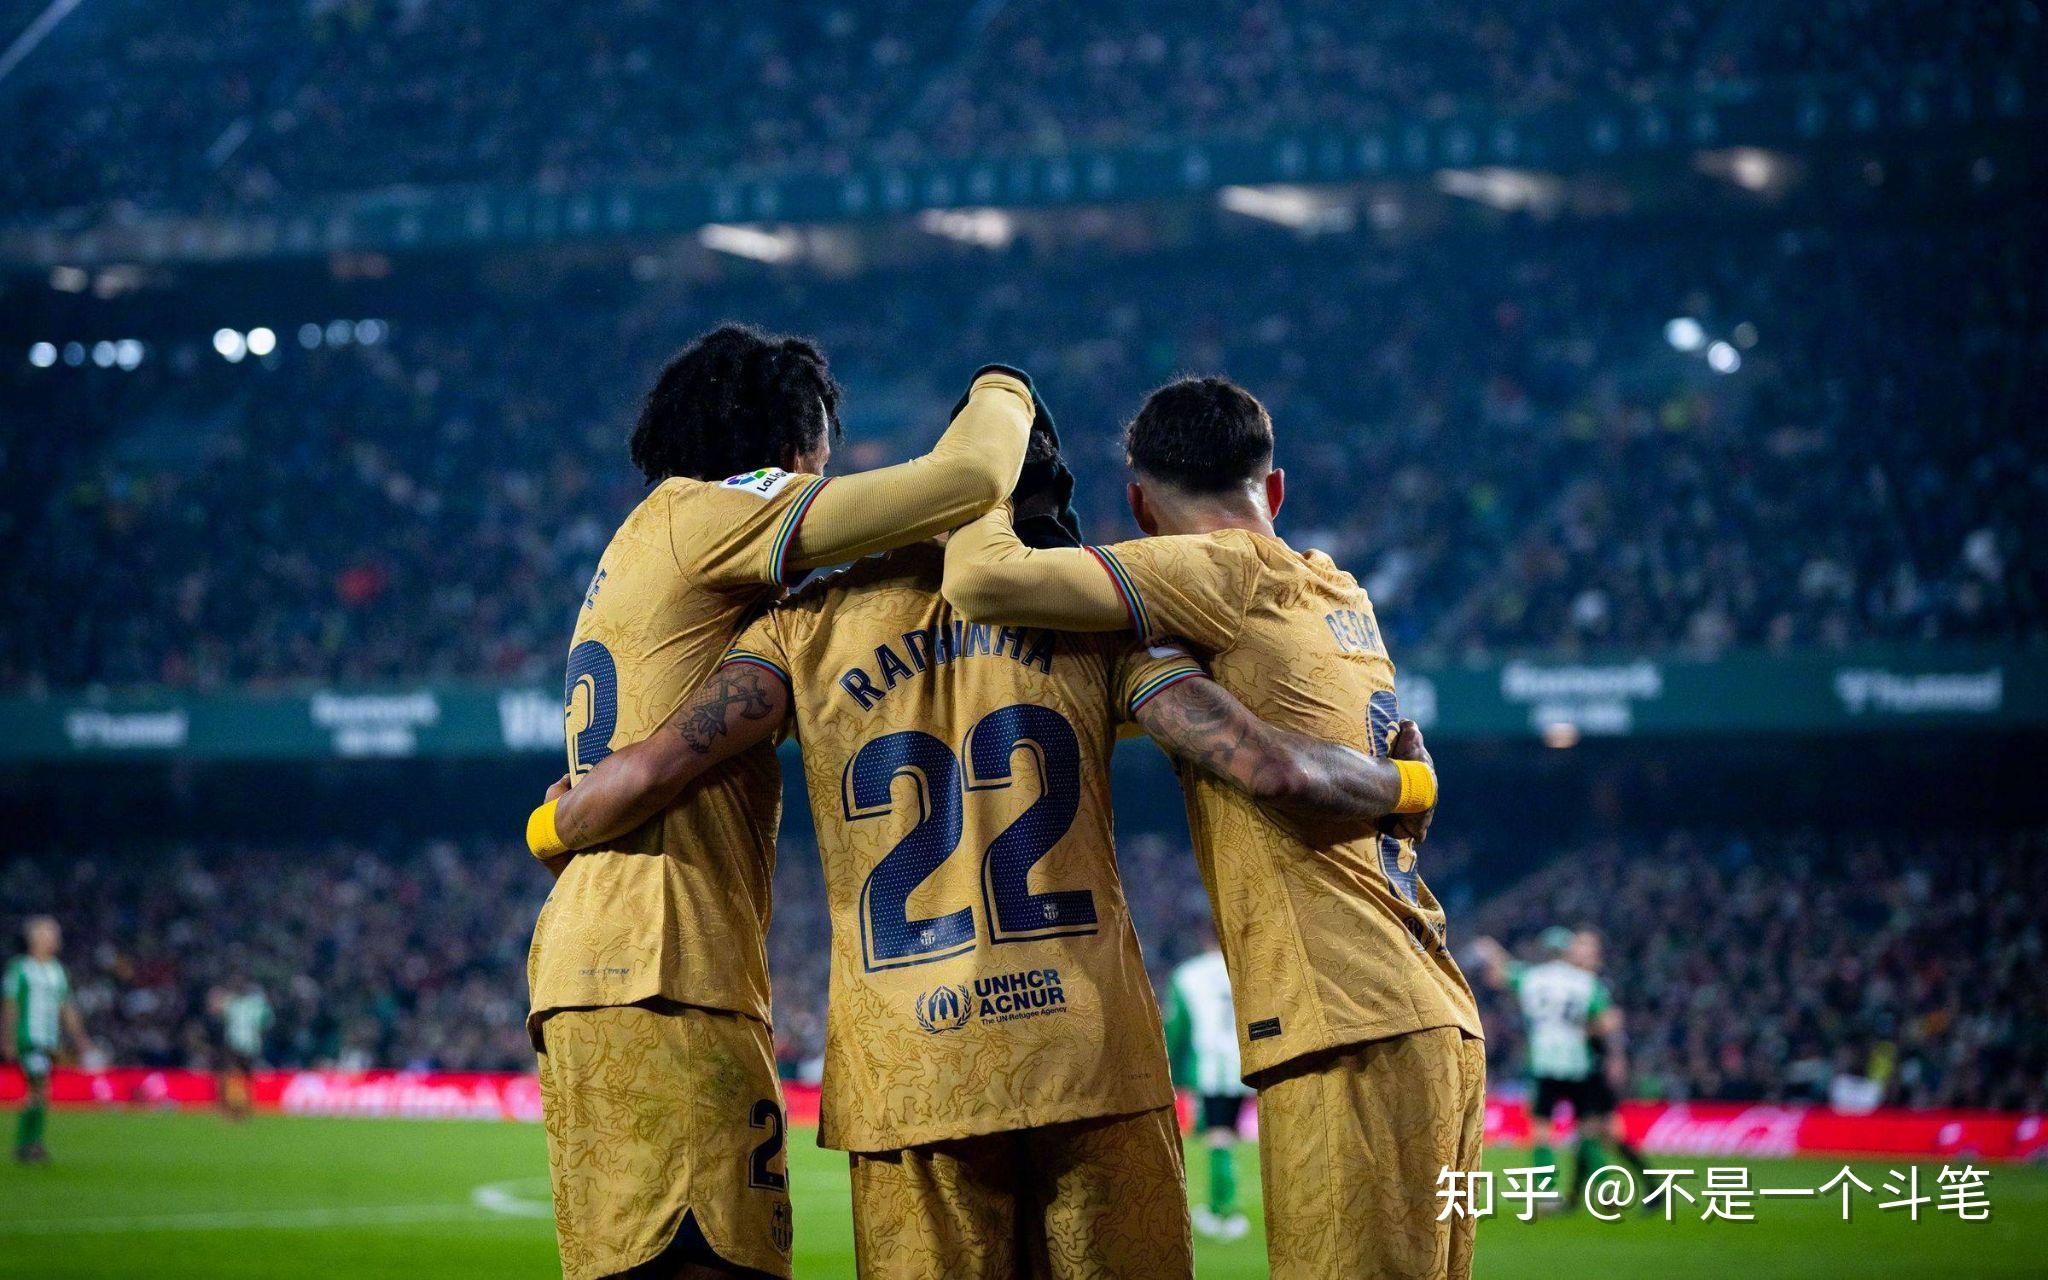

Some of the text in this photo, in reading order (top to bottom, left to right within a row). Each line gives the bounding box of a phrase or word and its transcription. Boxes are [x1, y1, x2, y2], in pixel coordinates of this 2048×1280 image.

[841, 703, 1098, 973] 22
[974, 968, 1062, 997] UNHCR
[979, 987, 1066, 1017] ACNUR
[982, 1007, 1068, 1025] The UN Refugee Agency
[749, 1099, 789, 1193] 2
